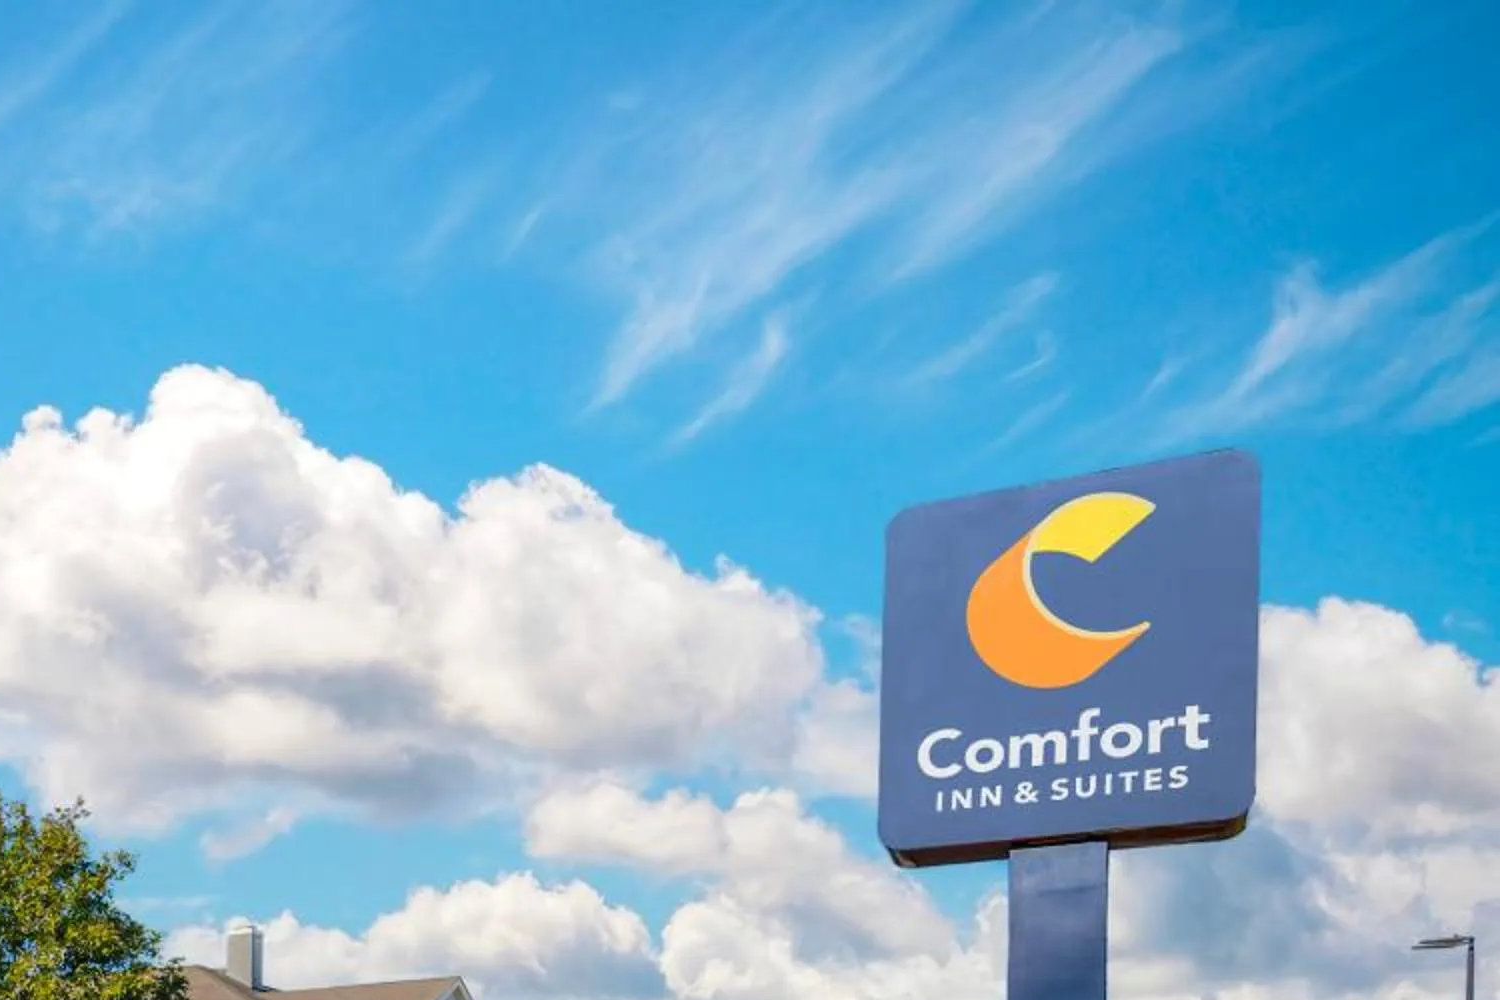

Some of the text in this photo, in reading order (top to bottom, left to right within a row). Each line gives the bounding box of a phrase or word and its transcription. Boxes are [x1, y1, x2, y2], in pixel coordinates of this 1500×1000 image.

[917, 704, 1211, 779] Comfort
[935, 765, 1190, 812] INN & SUITES
